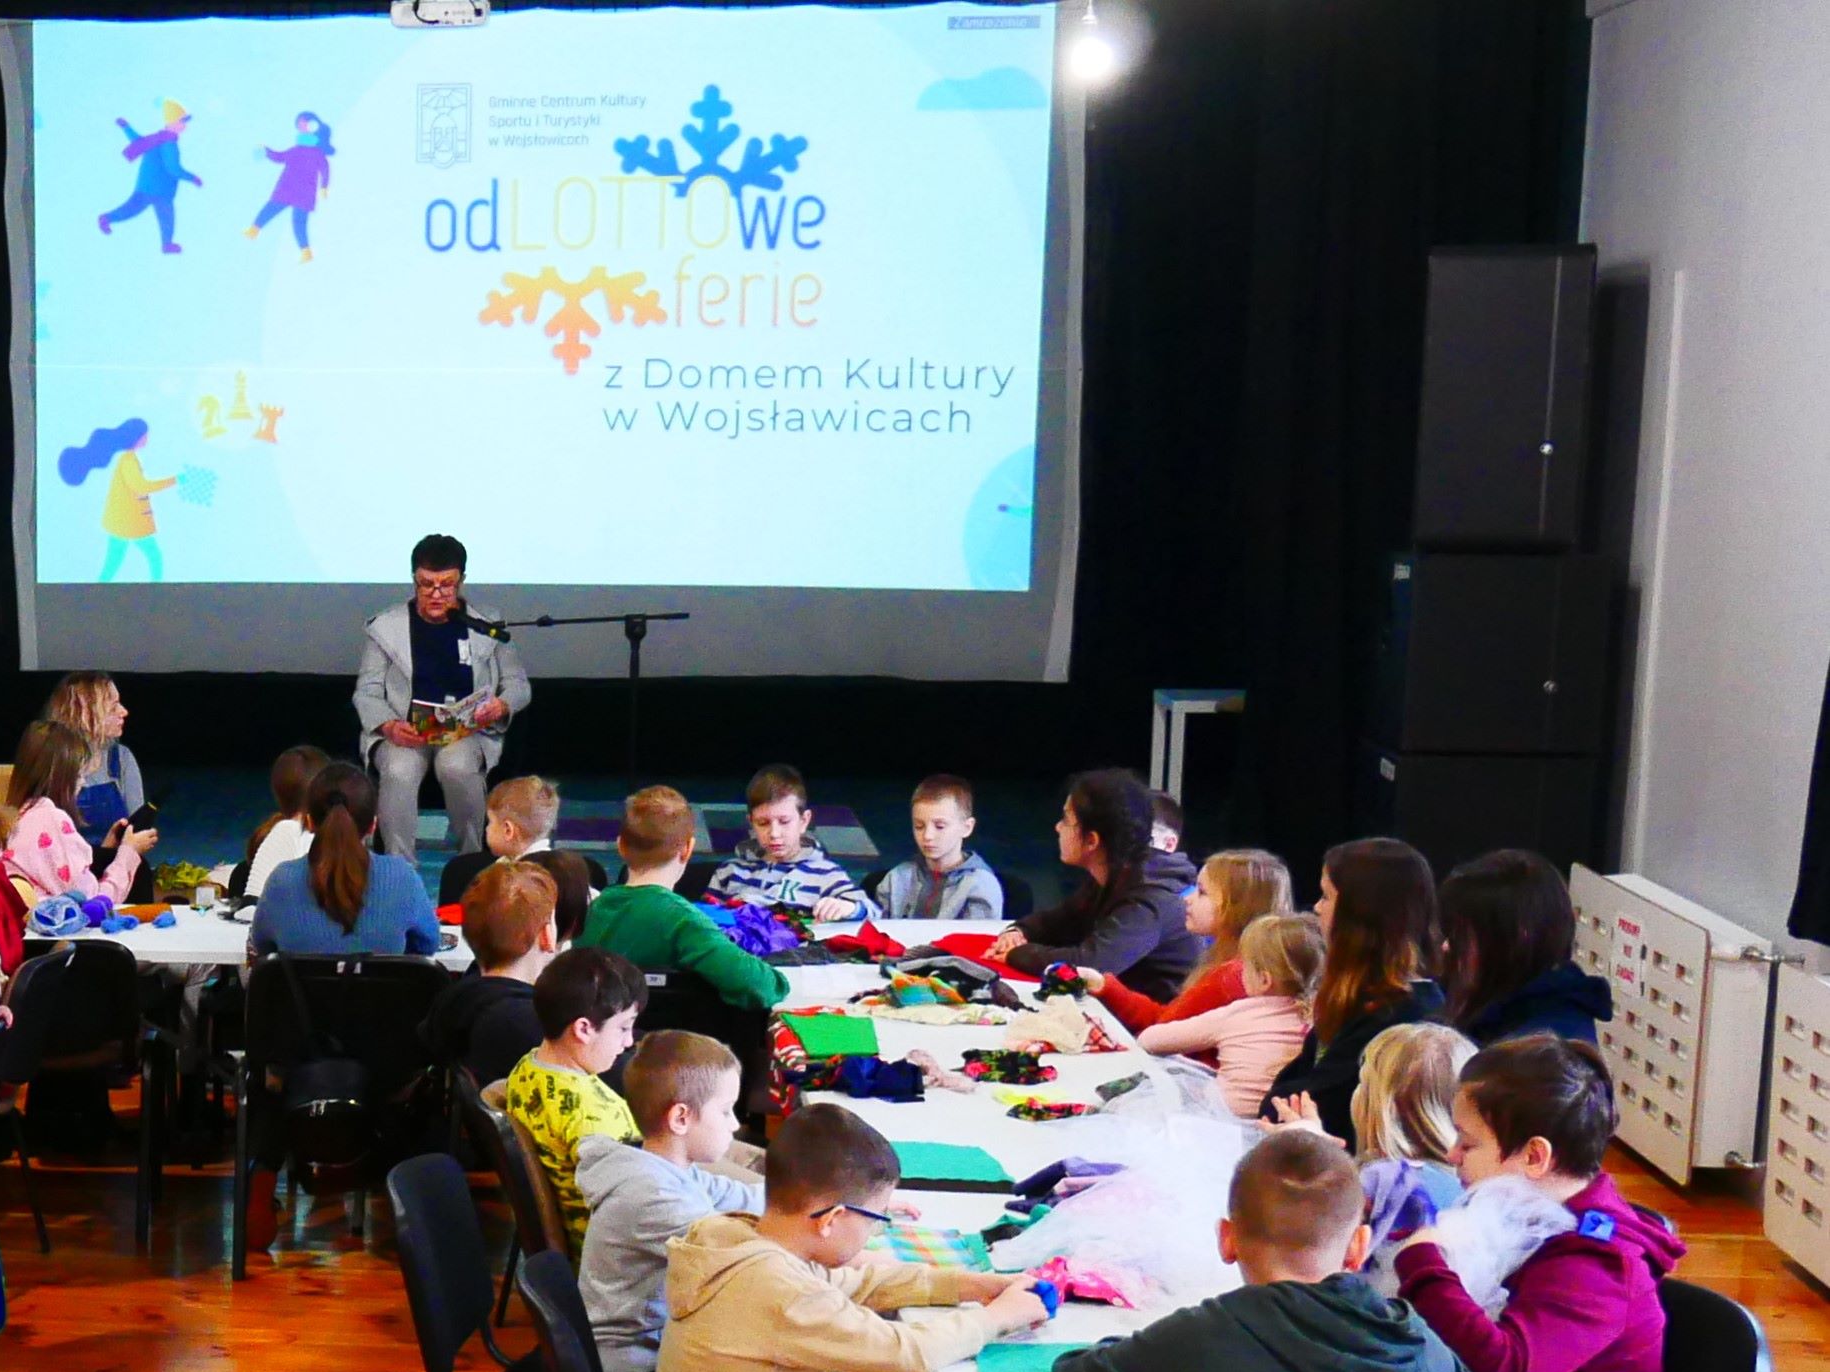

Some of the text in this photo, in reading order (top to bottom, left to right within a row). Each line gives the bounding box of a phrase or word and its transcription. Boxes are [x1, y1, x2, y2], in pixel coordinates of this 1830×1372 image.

[488, 94, 647, 109] Gminne Centrum Kultury
[488, 115, 532, 129] Sportu
[543, 114, 601, 128] Turystyki
[673, 254, 823, 328] ferie
[604, 357, 1016, 398] z Domem Kultury
[603, 400, 971, 440] w Wojsławicach
